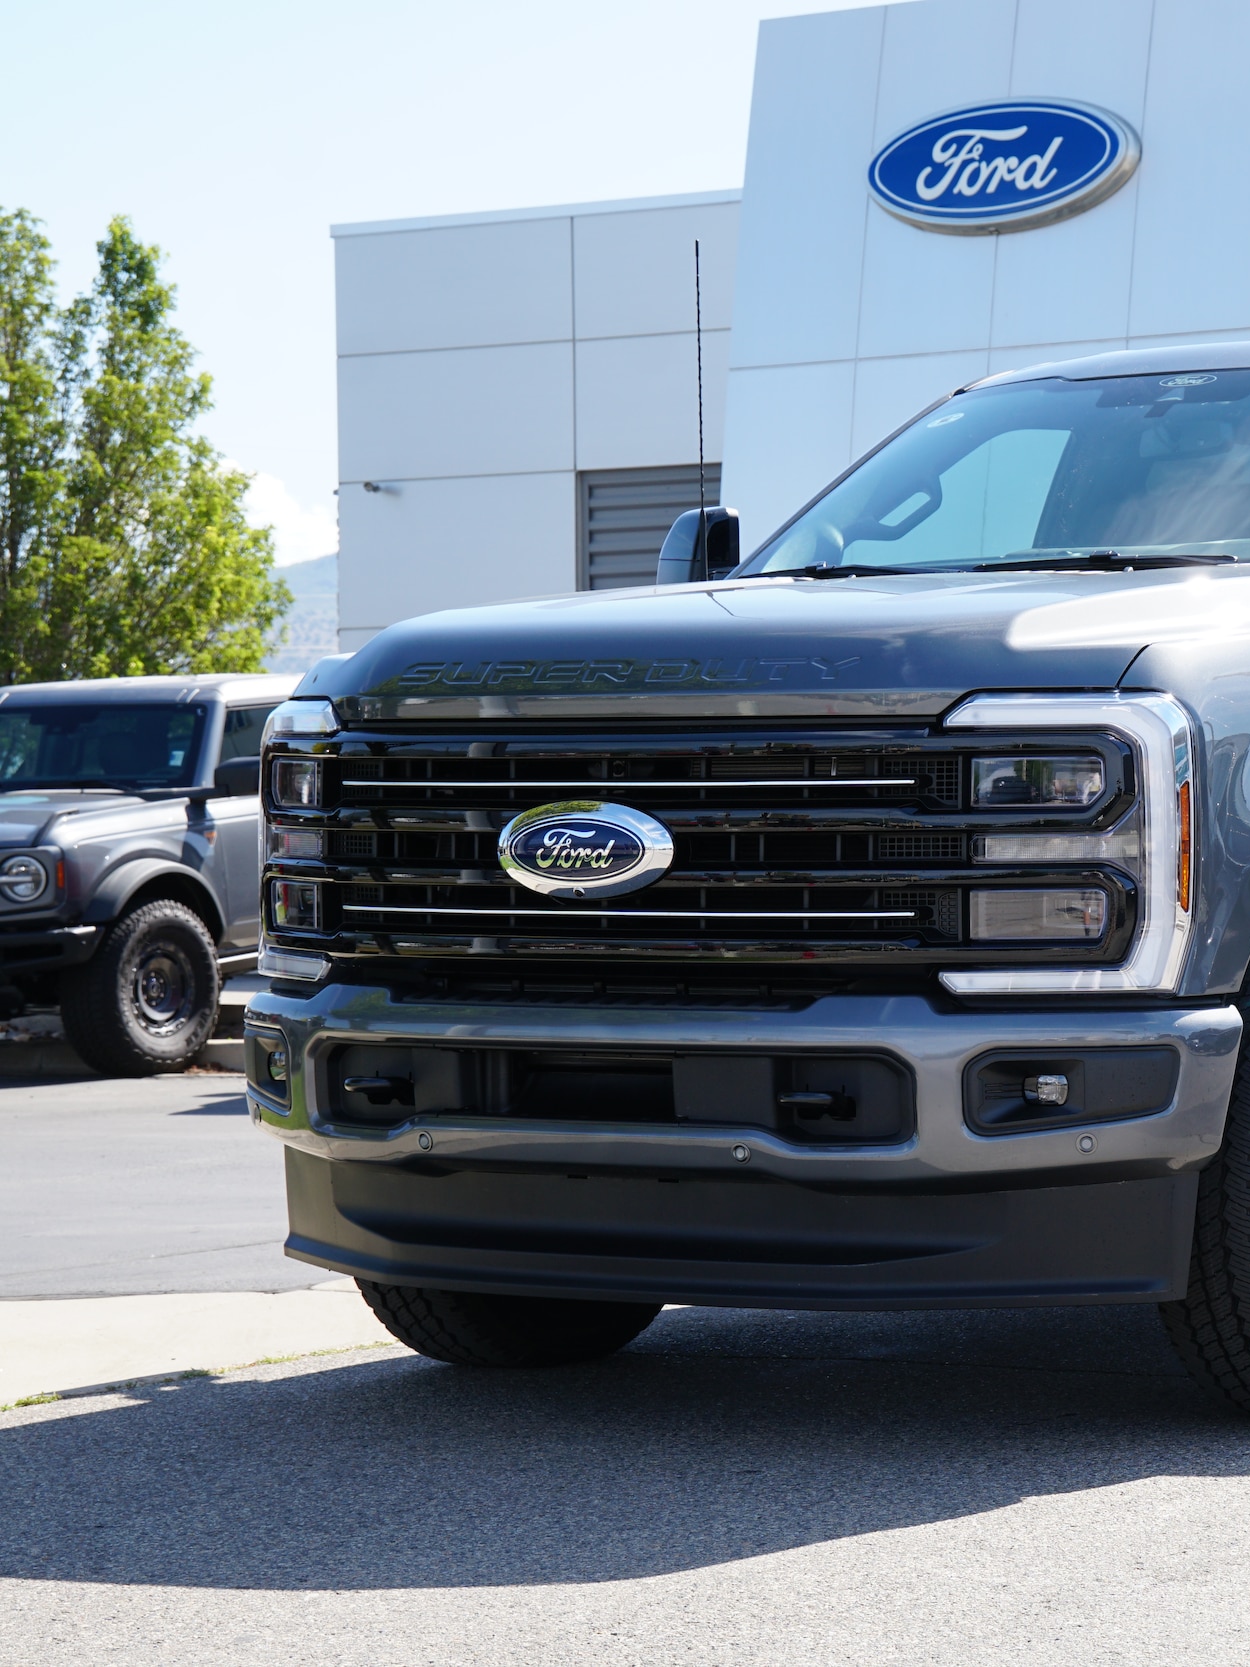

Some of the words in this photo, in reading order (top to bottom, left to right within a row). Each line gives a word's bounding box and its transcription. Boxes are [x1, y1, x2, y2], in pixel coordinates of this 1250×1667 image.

[915, 125, 1064, 201] Ford
[399, 659, 634, 685] SUPER
[643, 656, 862, 683] DUTY
[535, 828, 617, 869] Ford
